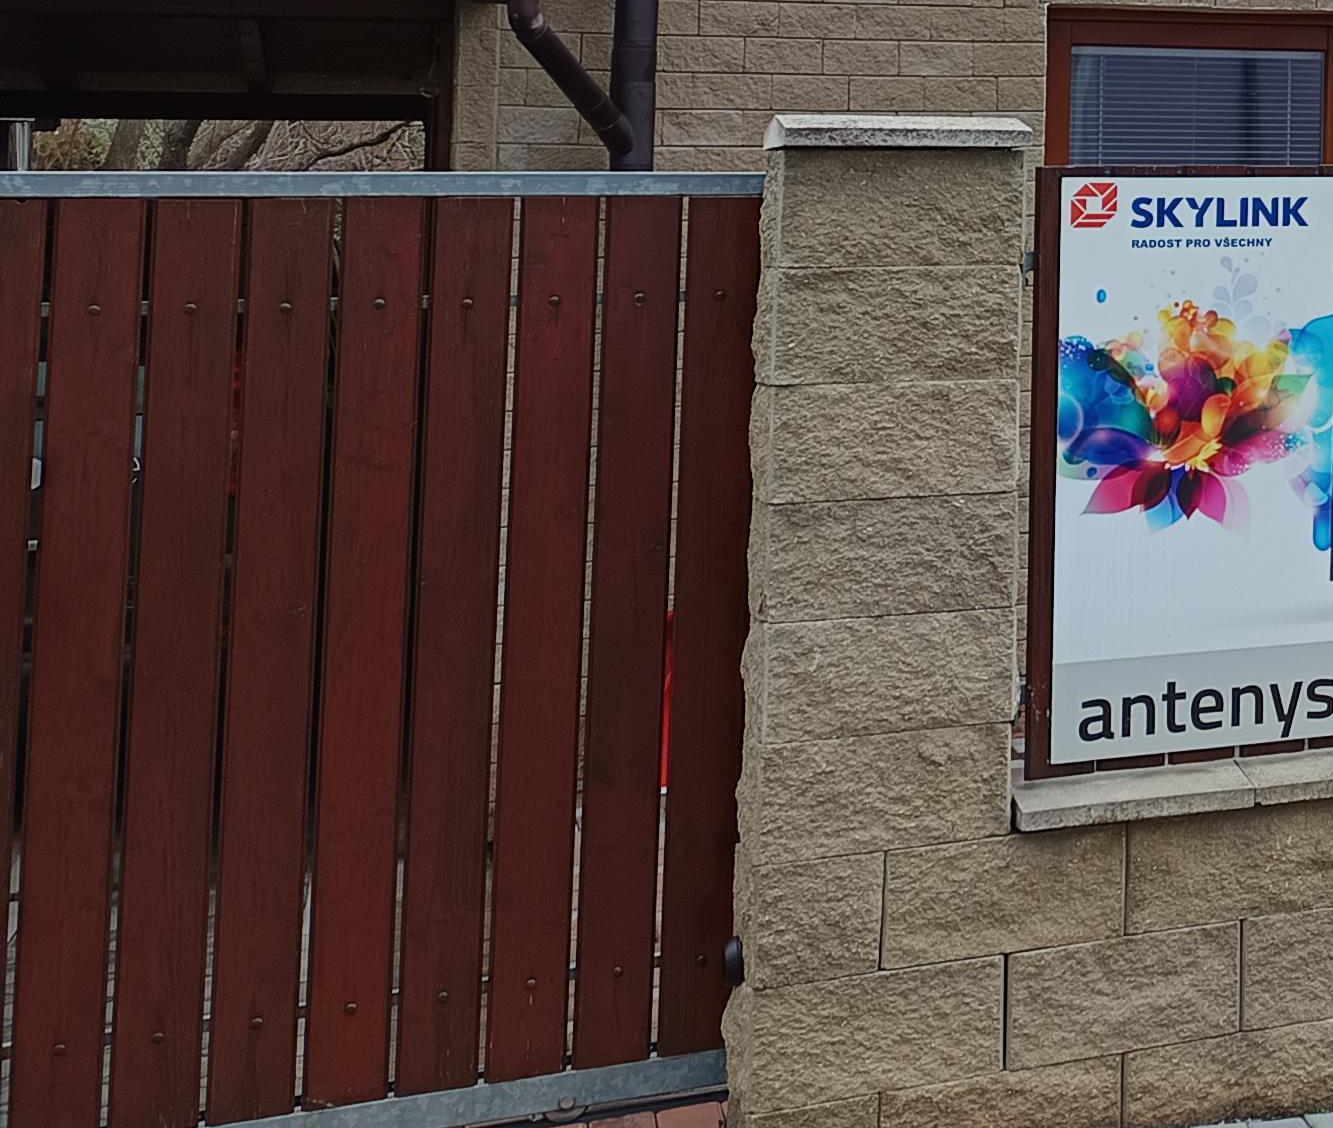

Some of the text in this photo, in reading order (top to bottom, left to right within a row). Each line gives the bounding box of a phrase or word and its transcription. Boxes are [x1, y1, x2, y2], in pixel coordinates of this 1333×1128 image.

[1130, 196, 1309, 229] SKYLINK
[1131, 236, 1273, 249] RADOST PRO VŠECHNY
